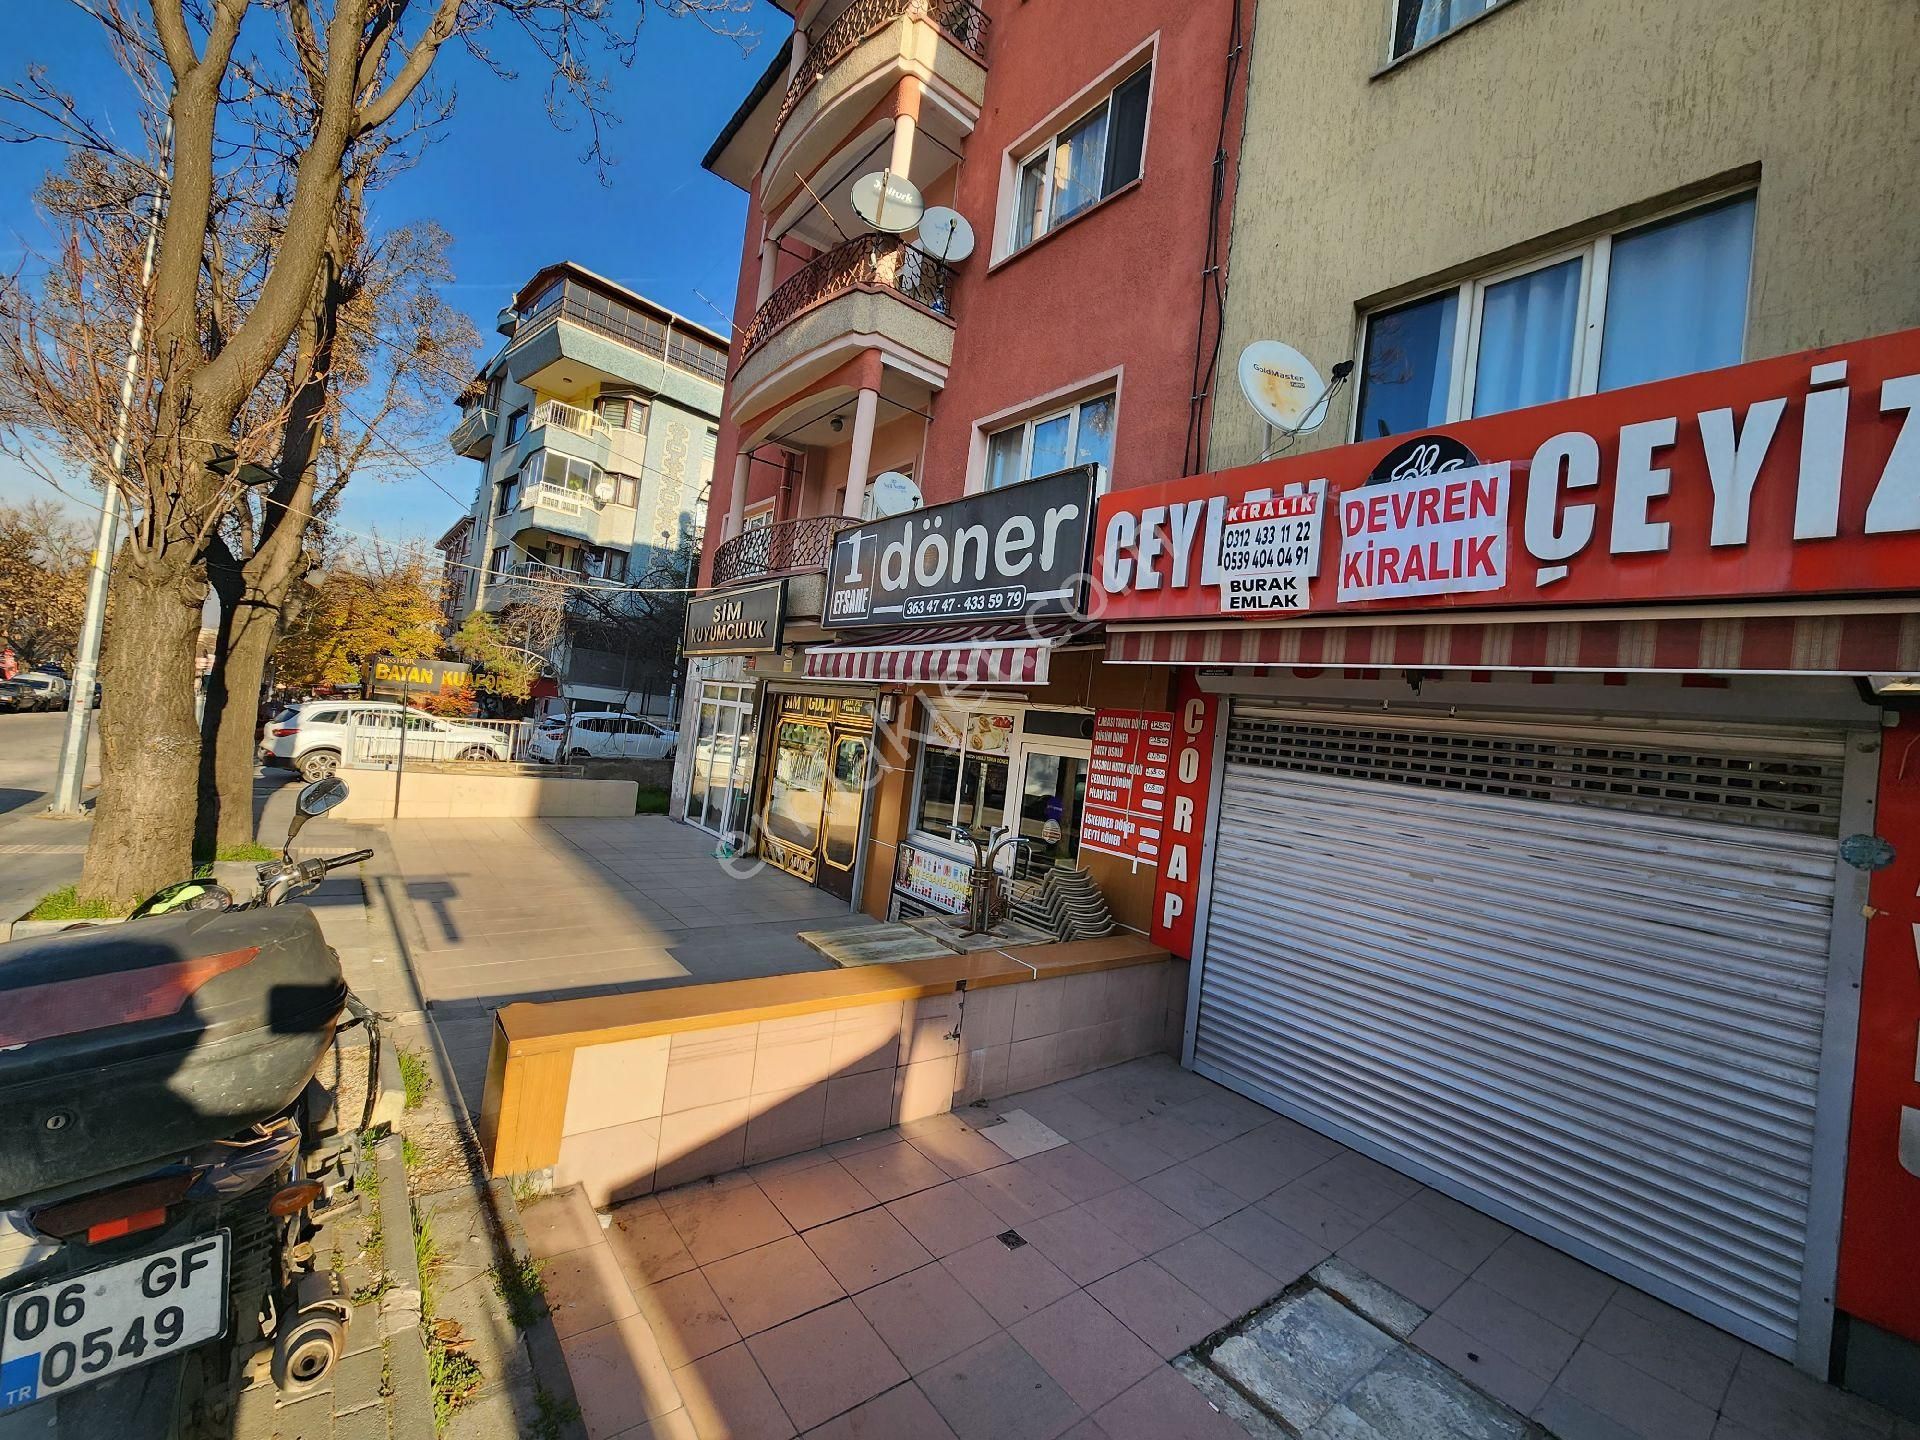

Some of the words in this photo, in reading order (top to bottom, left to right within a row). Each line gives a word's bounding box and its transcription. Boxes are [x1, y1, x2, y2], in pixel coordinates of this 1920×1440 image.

[1253, 363, 1304, 382] GoldMaster
[1345, 477, 1499, 538] DEVREN
[880, 504, 1079, 592] döner
[1103, 477, 1331, 594] CEYL
[1226, 528, 1250, 549] 0312
[1255, 525, 1275, 546] 433
[1281, 524, 1290, 543] 11
[1296, 522, 1310, 542] 22
[1224, 551, 1249, 571] 0539
[1252, 549, 1274, 569] 404
[1276, 547, 1292, 567] 04
[1295, 547, 1309, 566] 91
[1343, 534, 1499, 590] KİRALIK
[1229, 576, 1297, 593] BURAK
[713, 599, 743, 623] SİM
[833, 587, 869, 615] EFSANE
[906, 601, 924, 614] 363
[926, 601, 940, 612] 47
[941, 599, 954, 612] 47
[963, 595, 985, 610] 433
[988, 593, 1003, 607] 59
[1006, 591, 1021, 606] 79
[1229, 594, 1298, 609] EMLAK
[691, 619, 767, 644] KUYUMCULUK
[375, 663, 433, 684] BAYAN
[1163, 698, 1205, 929] ÇORAP
[1083, 827, 1101, 842] BEYTİ
[1101, 830, 1120, 846] DÖNER
[14, 1283, 86, 1341] 06
[142, 1242, 216, 1298] GF
[42, 1306, 184, 1387] 0549
[7, 1385, 32, 1405] TR
